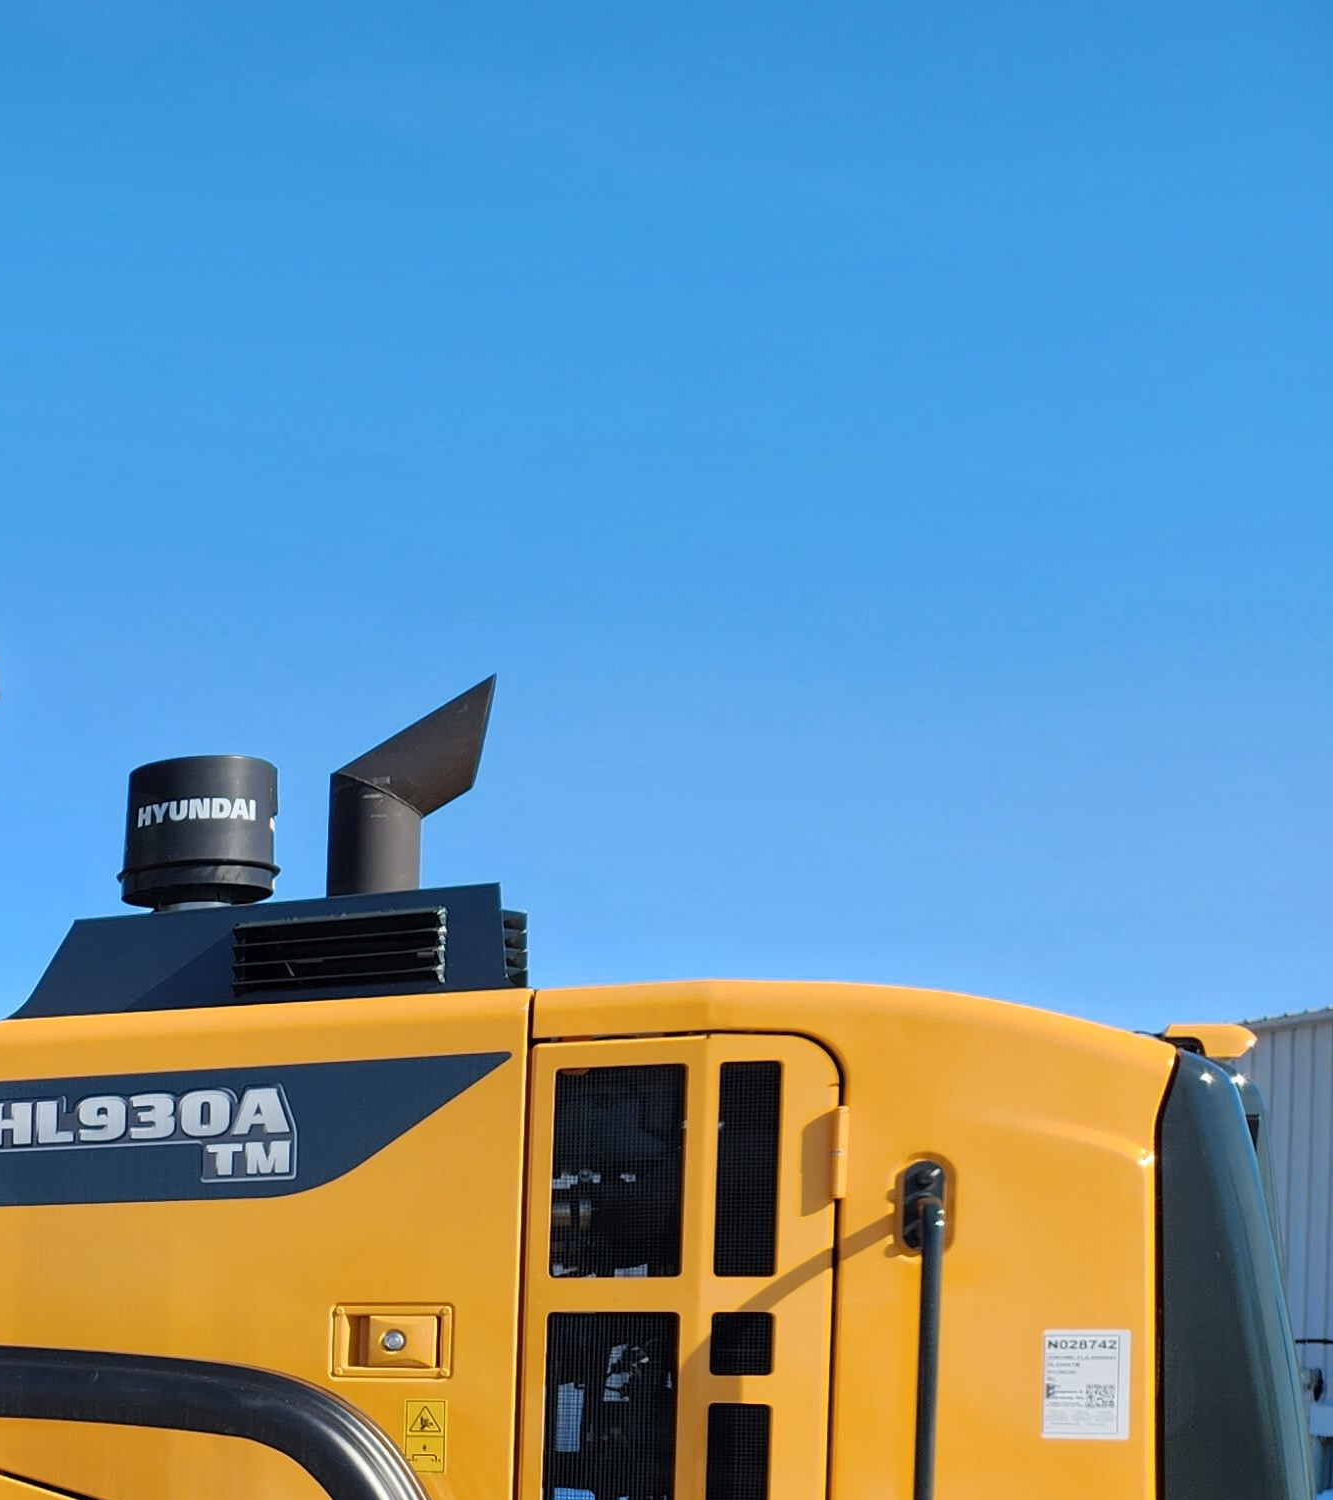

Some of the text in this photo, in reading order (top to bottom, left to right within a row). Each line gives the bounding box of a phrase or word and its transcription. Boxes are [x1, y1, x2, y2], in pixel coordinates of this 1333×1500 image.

[137, 797, 257, 828] HYUNDAI
[206, 1140, 292, 1177] TM
[1047, 1339, 1117, 1350] N028742
